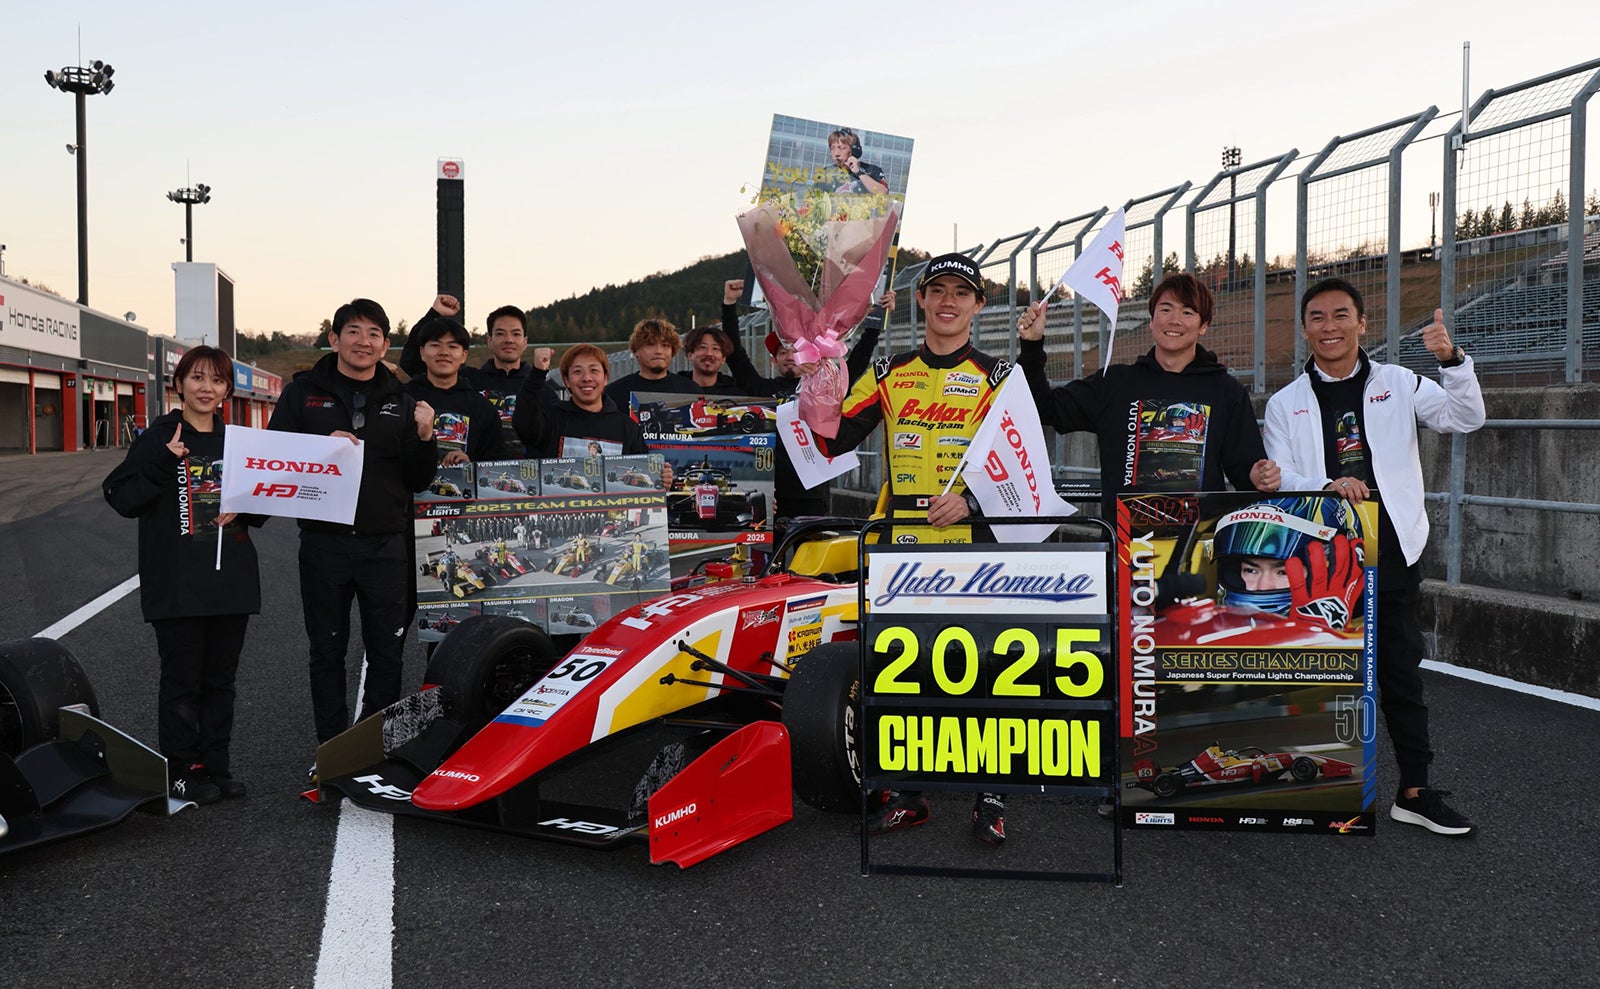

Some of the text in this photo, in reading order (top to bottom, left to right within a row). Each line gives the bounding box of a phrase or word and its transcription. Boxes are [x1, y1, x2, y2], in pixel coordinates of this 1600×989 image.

[768, 162, 850, 184] You are
[931, 260, 974, 276] KUMHO
[9, 306, 76, 340] Honda RACING
[954, 376, 979, 384] LIGHTS
[898, 398, 972, 422] B-Max
[896, 418, 936, 430] Racing
[660, 432, 693, 441] KIMURA
[1123, 400, 1140, 486] YUTO NOMURA
[244, 457, 342, 476] HONDA
[521, 459, 538, 480] 50
[584, 456, 600, 477] 51
[755, 447, 774, 472] 50
[896, 474, 916, 483] SPK
[996, 486, 1012, 512] PROJECT
[1000, 484, 1014, 506] DREAM
[1005, 483, 1022, 512] FORMULA
[1010, 482, 1021, 501] Honda
[178, 487, 190, 536] NOMURA
[466, 496, 665, 513] 2025 TEAM CHAMPION
[1131, 497, 1200, 526] 2025
[1230, 512, 1284, 523] HONDA
[874, 562, 1094, 607] Yuto Nomura
[1132, 531, 1156, 736] YUTO NOMURA
[581, 647, 624, 655] ThreeBond
[874, 626, 1104, 698] 2025
[1162, 652, 1358, 670] SERIES CHAMPION
[547, 658, 607, 681] 50
[1267, 672, 1292, 680] Lights
[1294, 672, 1353, 680] Championship
[1335, 694, 1376, 743] 50
[878, 714, 1100, 778] CHAMPION
[432, 769, 480, 782] KUMHO
[655, 803, 696, 828] KUMHO
